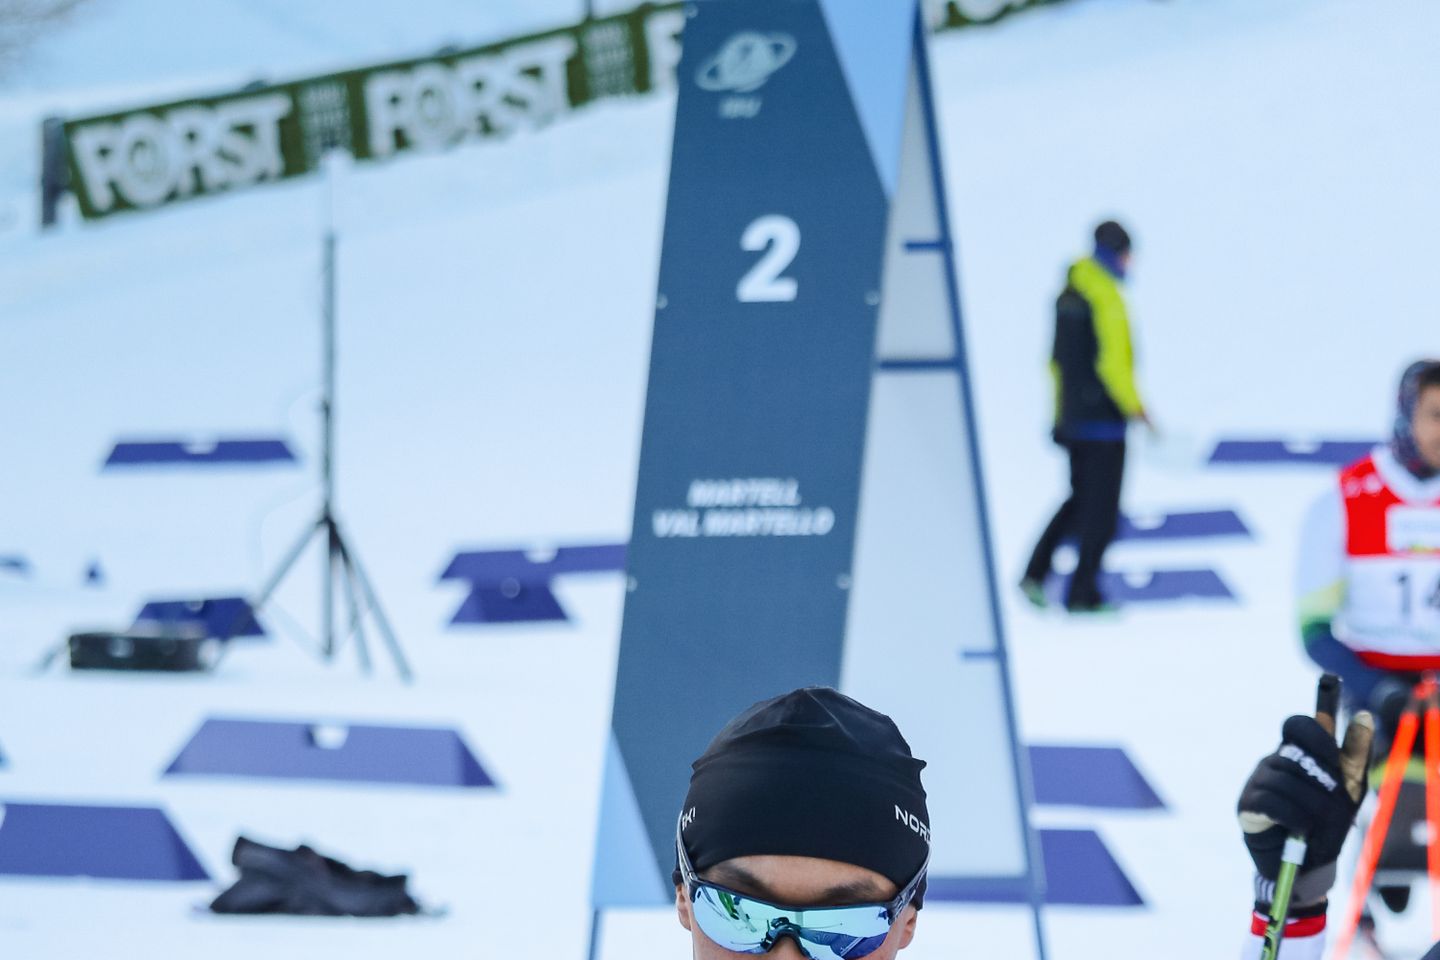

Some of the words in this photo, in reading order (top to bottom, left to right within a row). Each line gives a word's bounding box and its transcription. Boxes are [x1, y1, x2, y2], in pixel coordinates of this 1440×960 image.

[362, 32, 578, 157] FORST
[70, 96, 293, 212] FORST
[737, 213, 801, 302] 2
